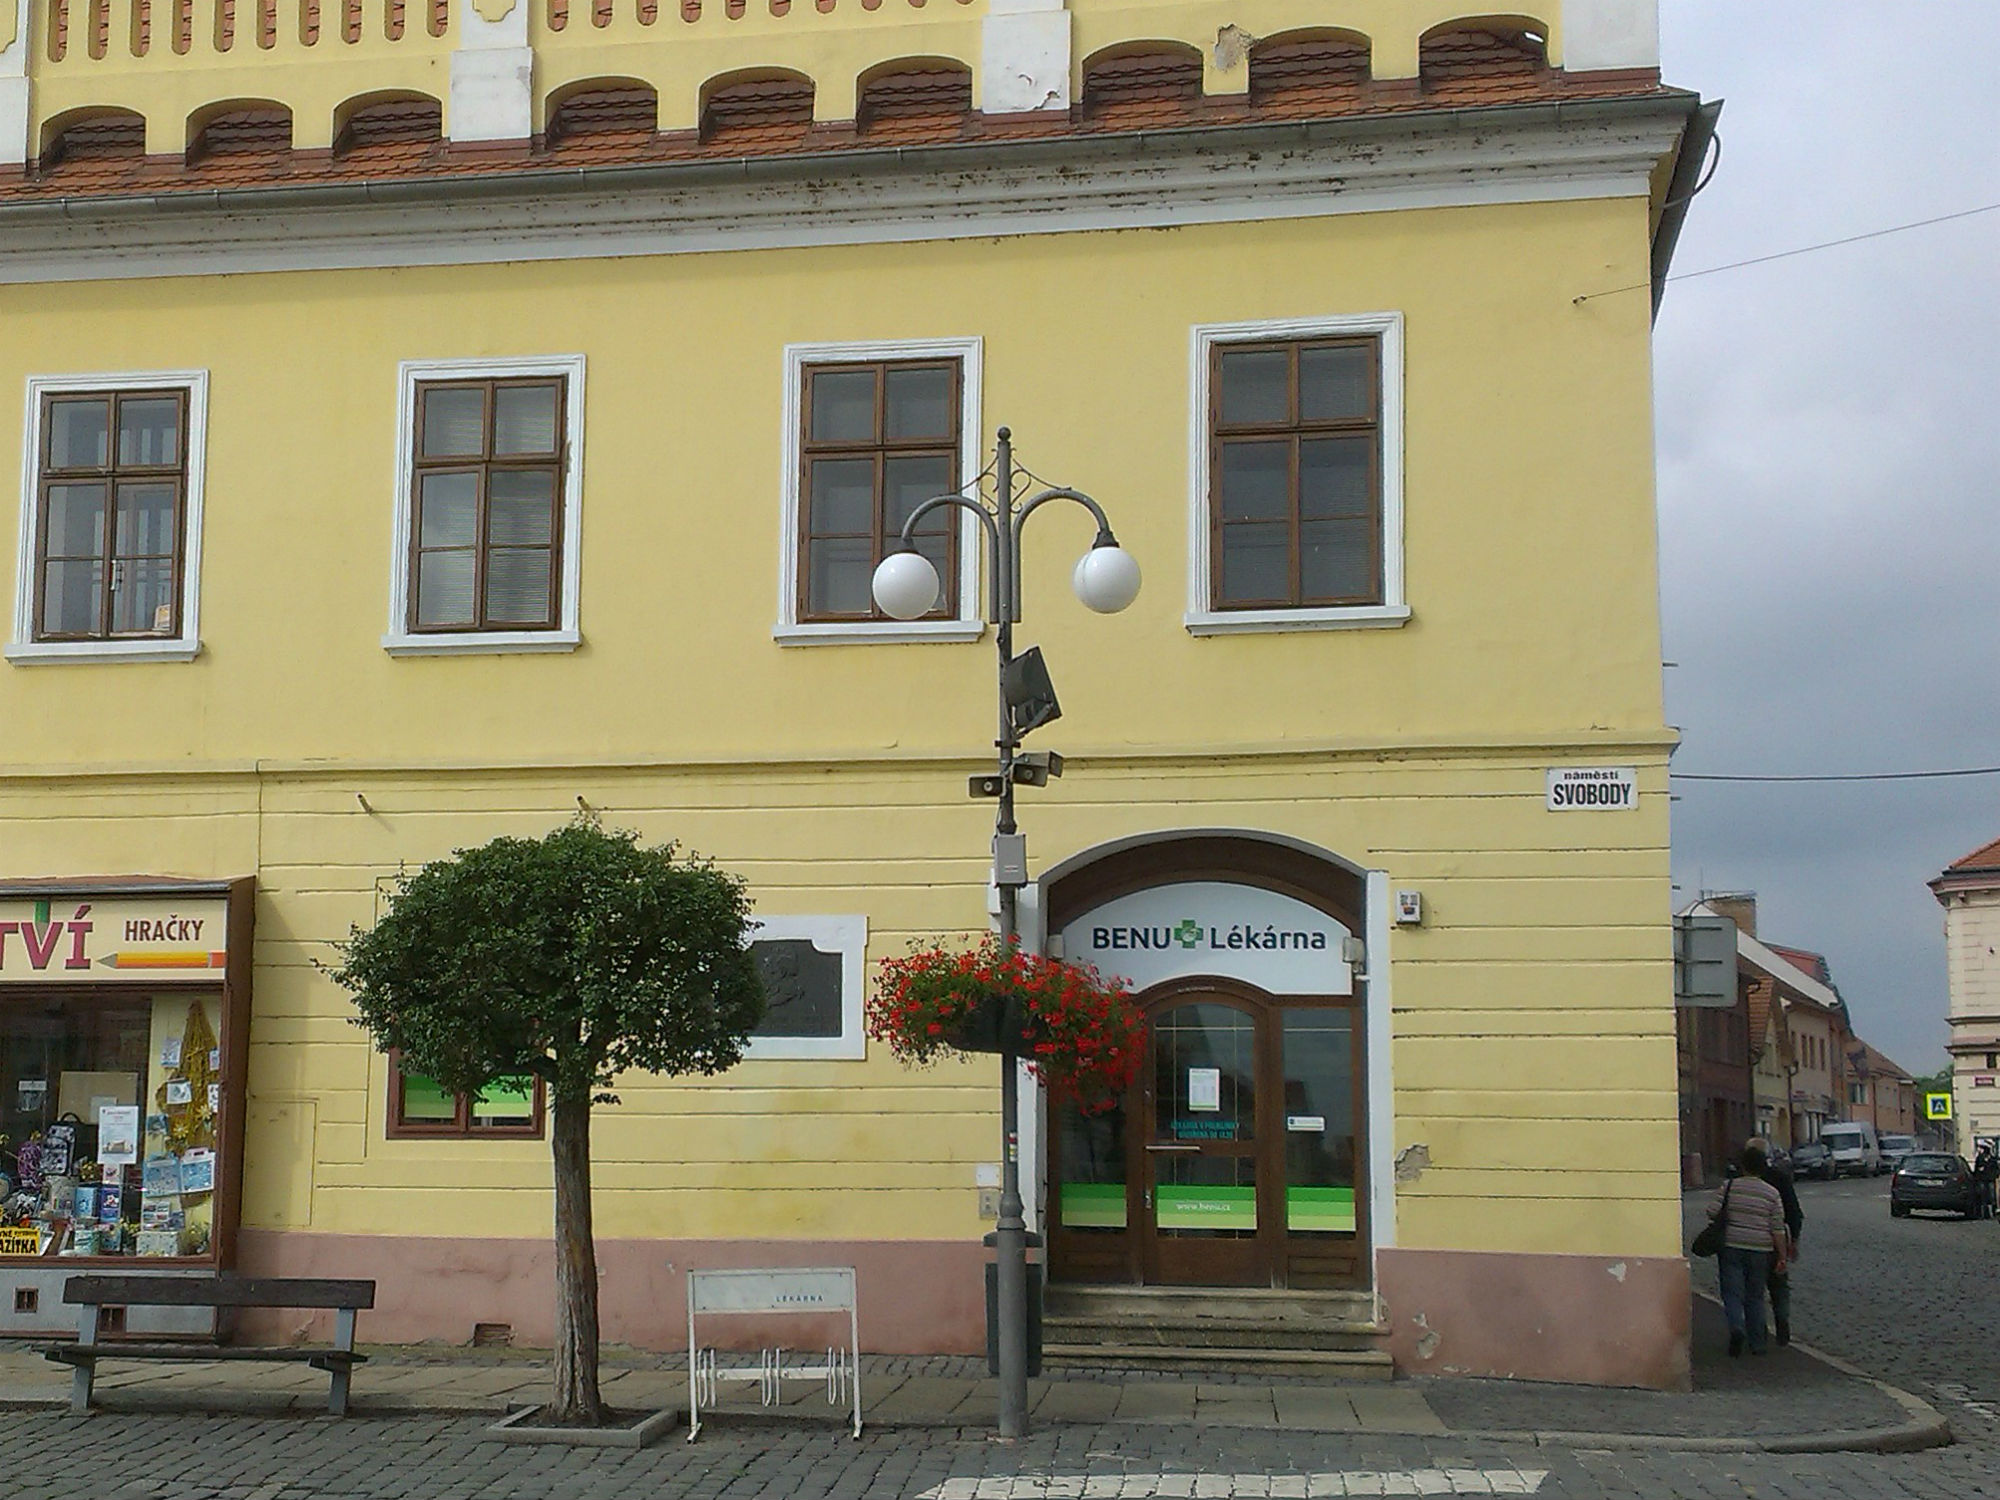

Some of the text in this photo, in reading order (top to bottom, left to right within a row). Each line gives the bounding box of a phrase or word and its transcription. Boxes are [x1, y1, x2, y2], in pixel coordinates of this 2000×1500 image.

[1563, 770, 1618, 780] náměstí
[1553, 783, 1631, 806] SVOBODY
[124, 914, 204, 941] HRAČKY
[1092, 924, 1327, 950] BENU Lékárna
